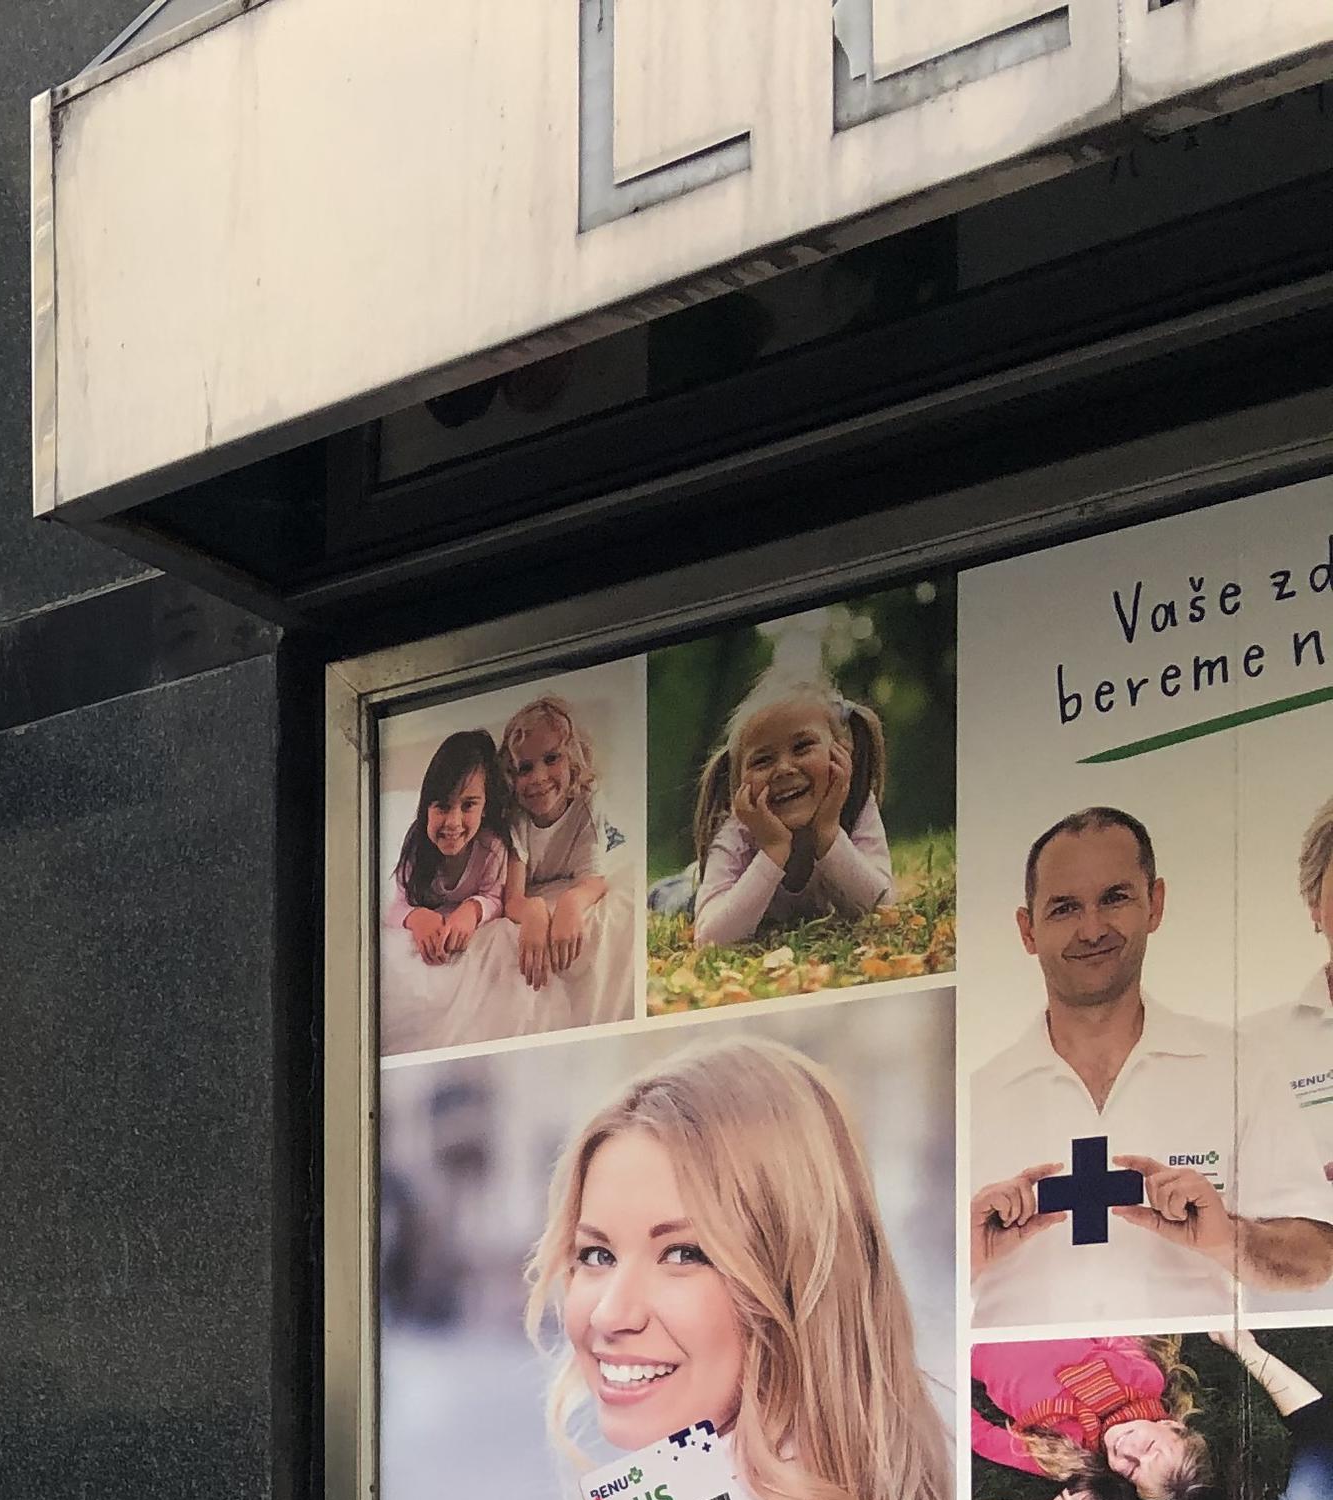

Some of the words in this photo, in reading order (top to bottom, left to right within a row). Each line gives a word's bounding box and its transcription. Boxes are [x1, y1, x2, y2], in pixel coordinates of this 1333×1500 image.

[1112, 576, 1242, 643] Vaše
[1057, 644, 1265, 725] bereme
[1169, 1154, 1205, 1166] BENU
[590, 1476, 629, 1500] BENU
